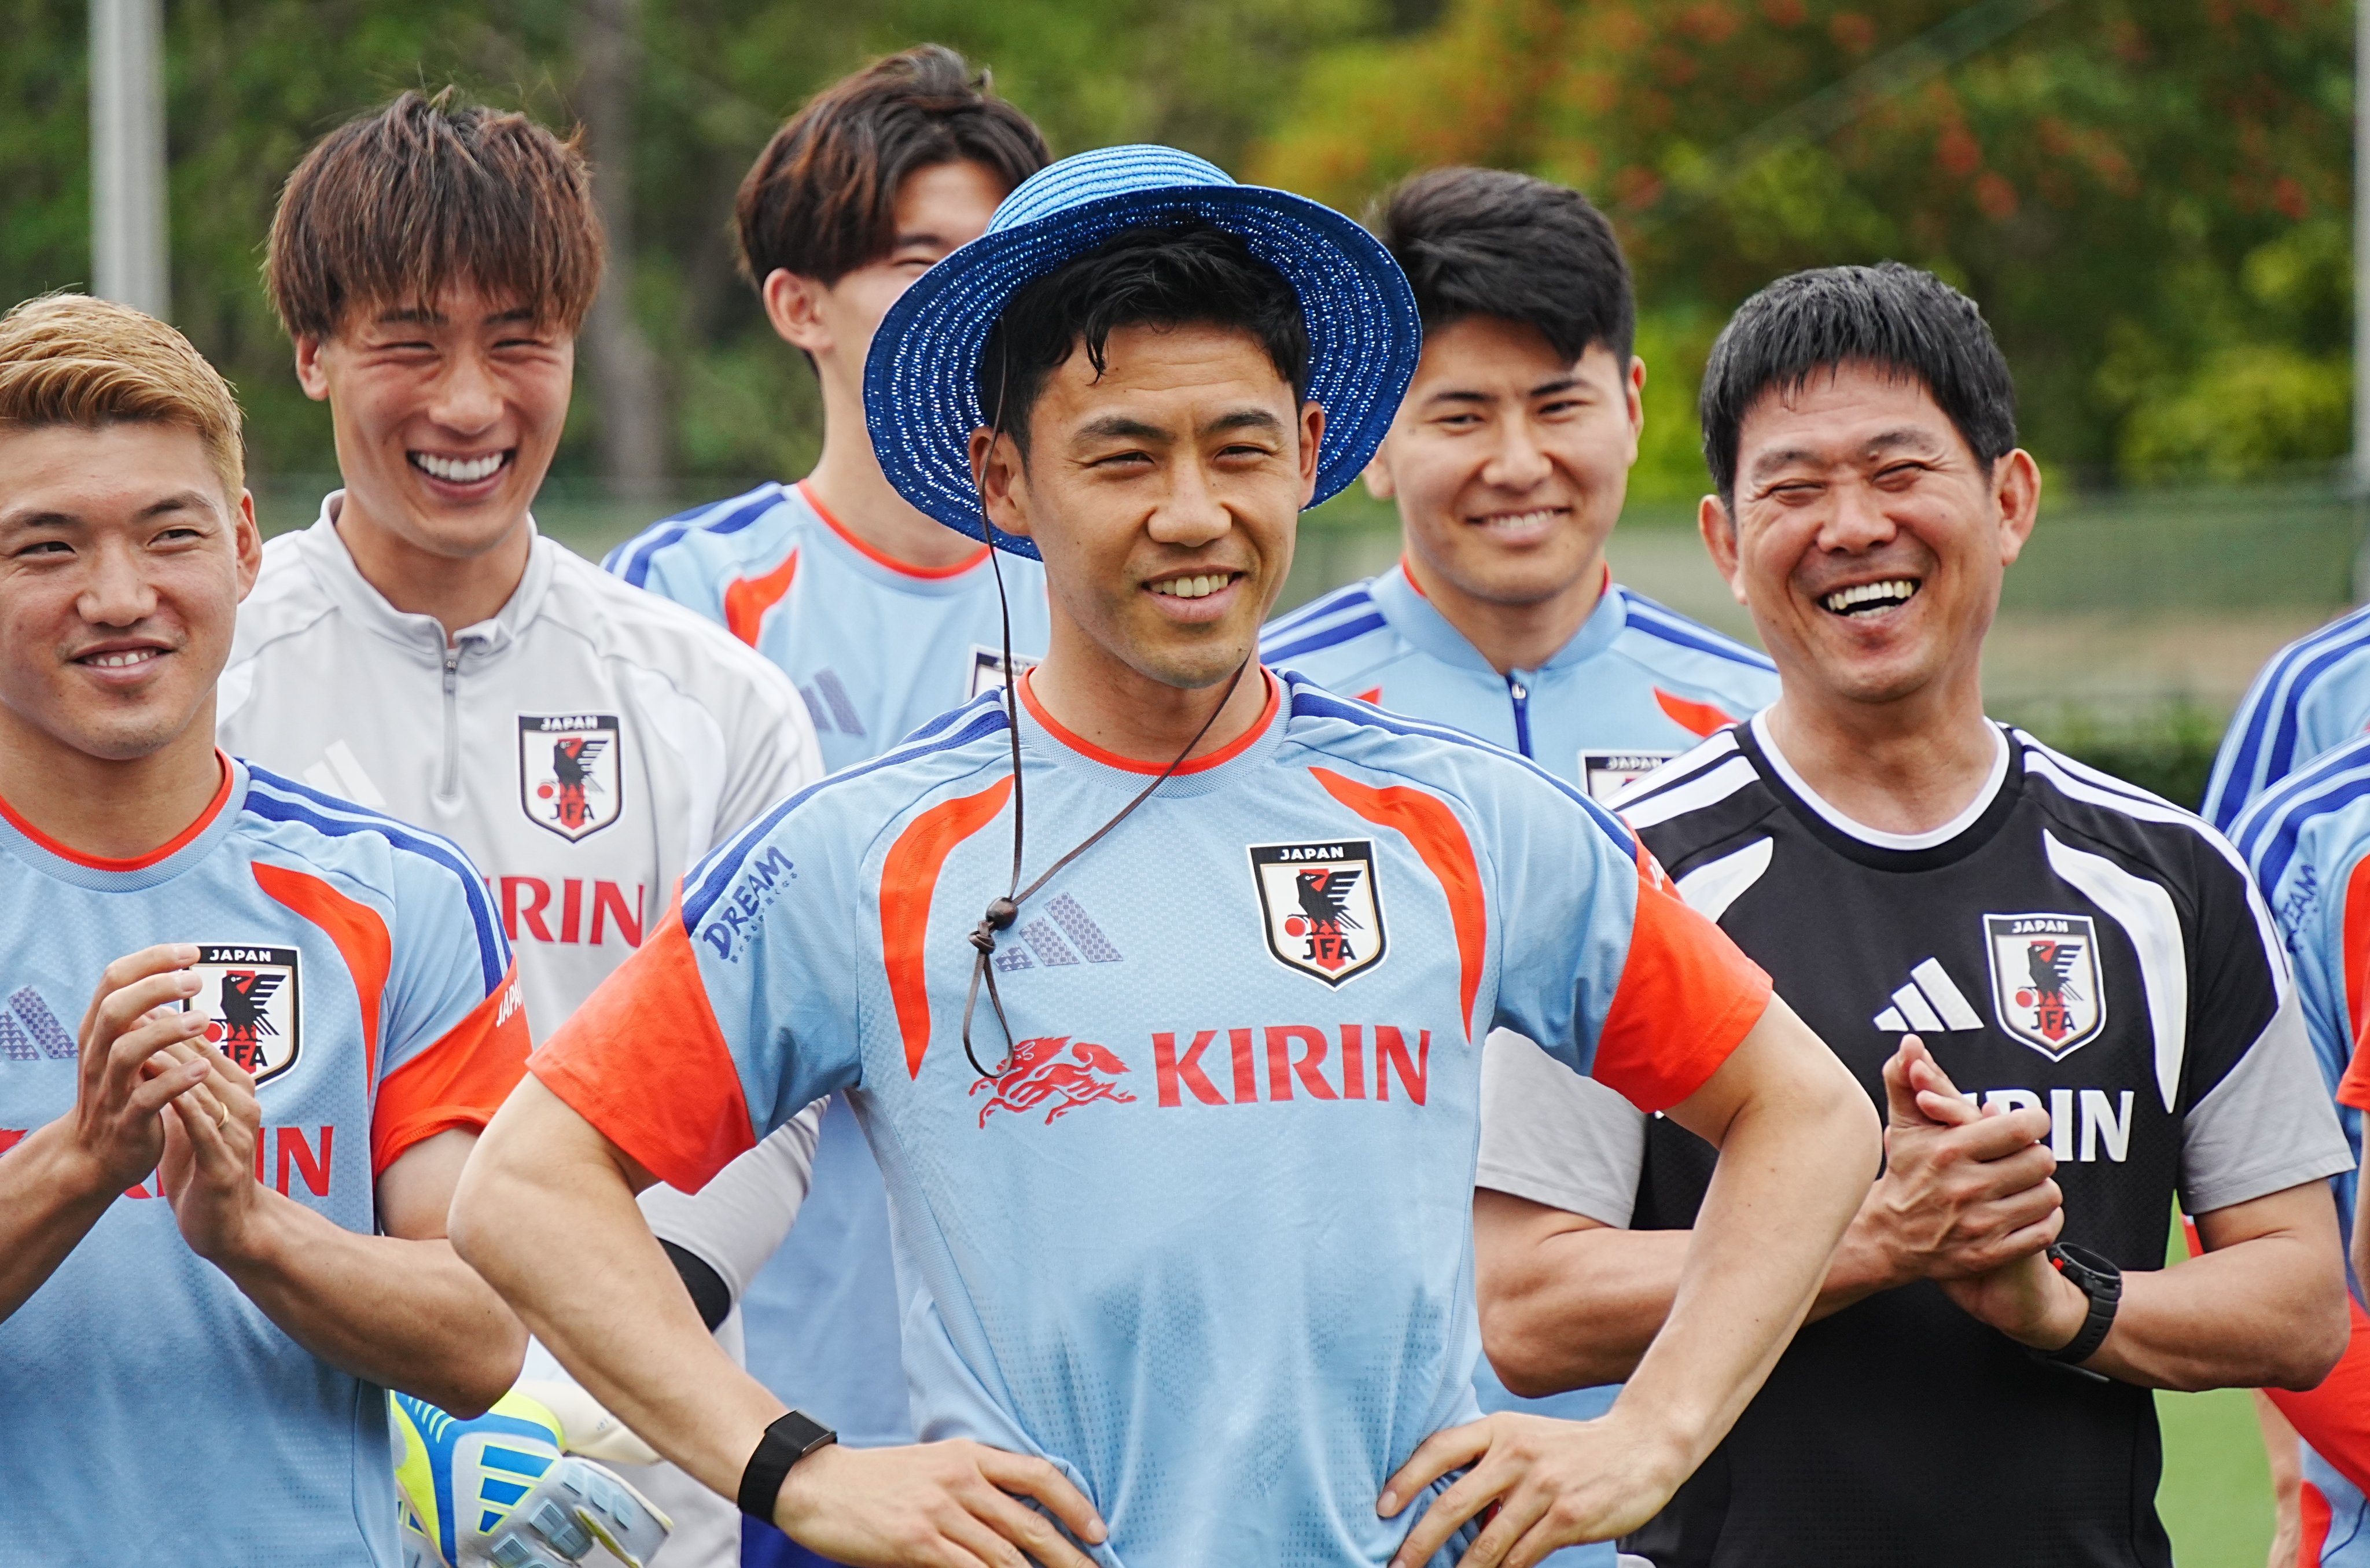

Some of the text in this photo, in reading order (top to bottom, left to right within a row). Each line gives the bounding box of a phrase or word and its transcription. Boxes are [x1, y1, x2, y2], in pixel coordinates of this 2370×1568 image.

[541, 716, 598, 731] JAPAN
[550, 804, 595, 819] JFA
[1280, 846, 1344, 860] JAPAN
[484, 877, 643, 948] RIN
[703, 846, 794, 960] DREAM
[2012, 920, 2069, 933] JAPAN
[209, 949, 271, 962] JAPAN
[1302, 938, 1357, 960] JFA
[496, 976, 522, 1028] JAPA
[2030, 1011, 2077, 1030] JFA
[1151, 1024, 1431, 1107] KIRIN
